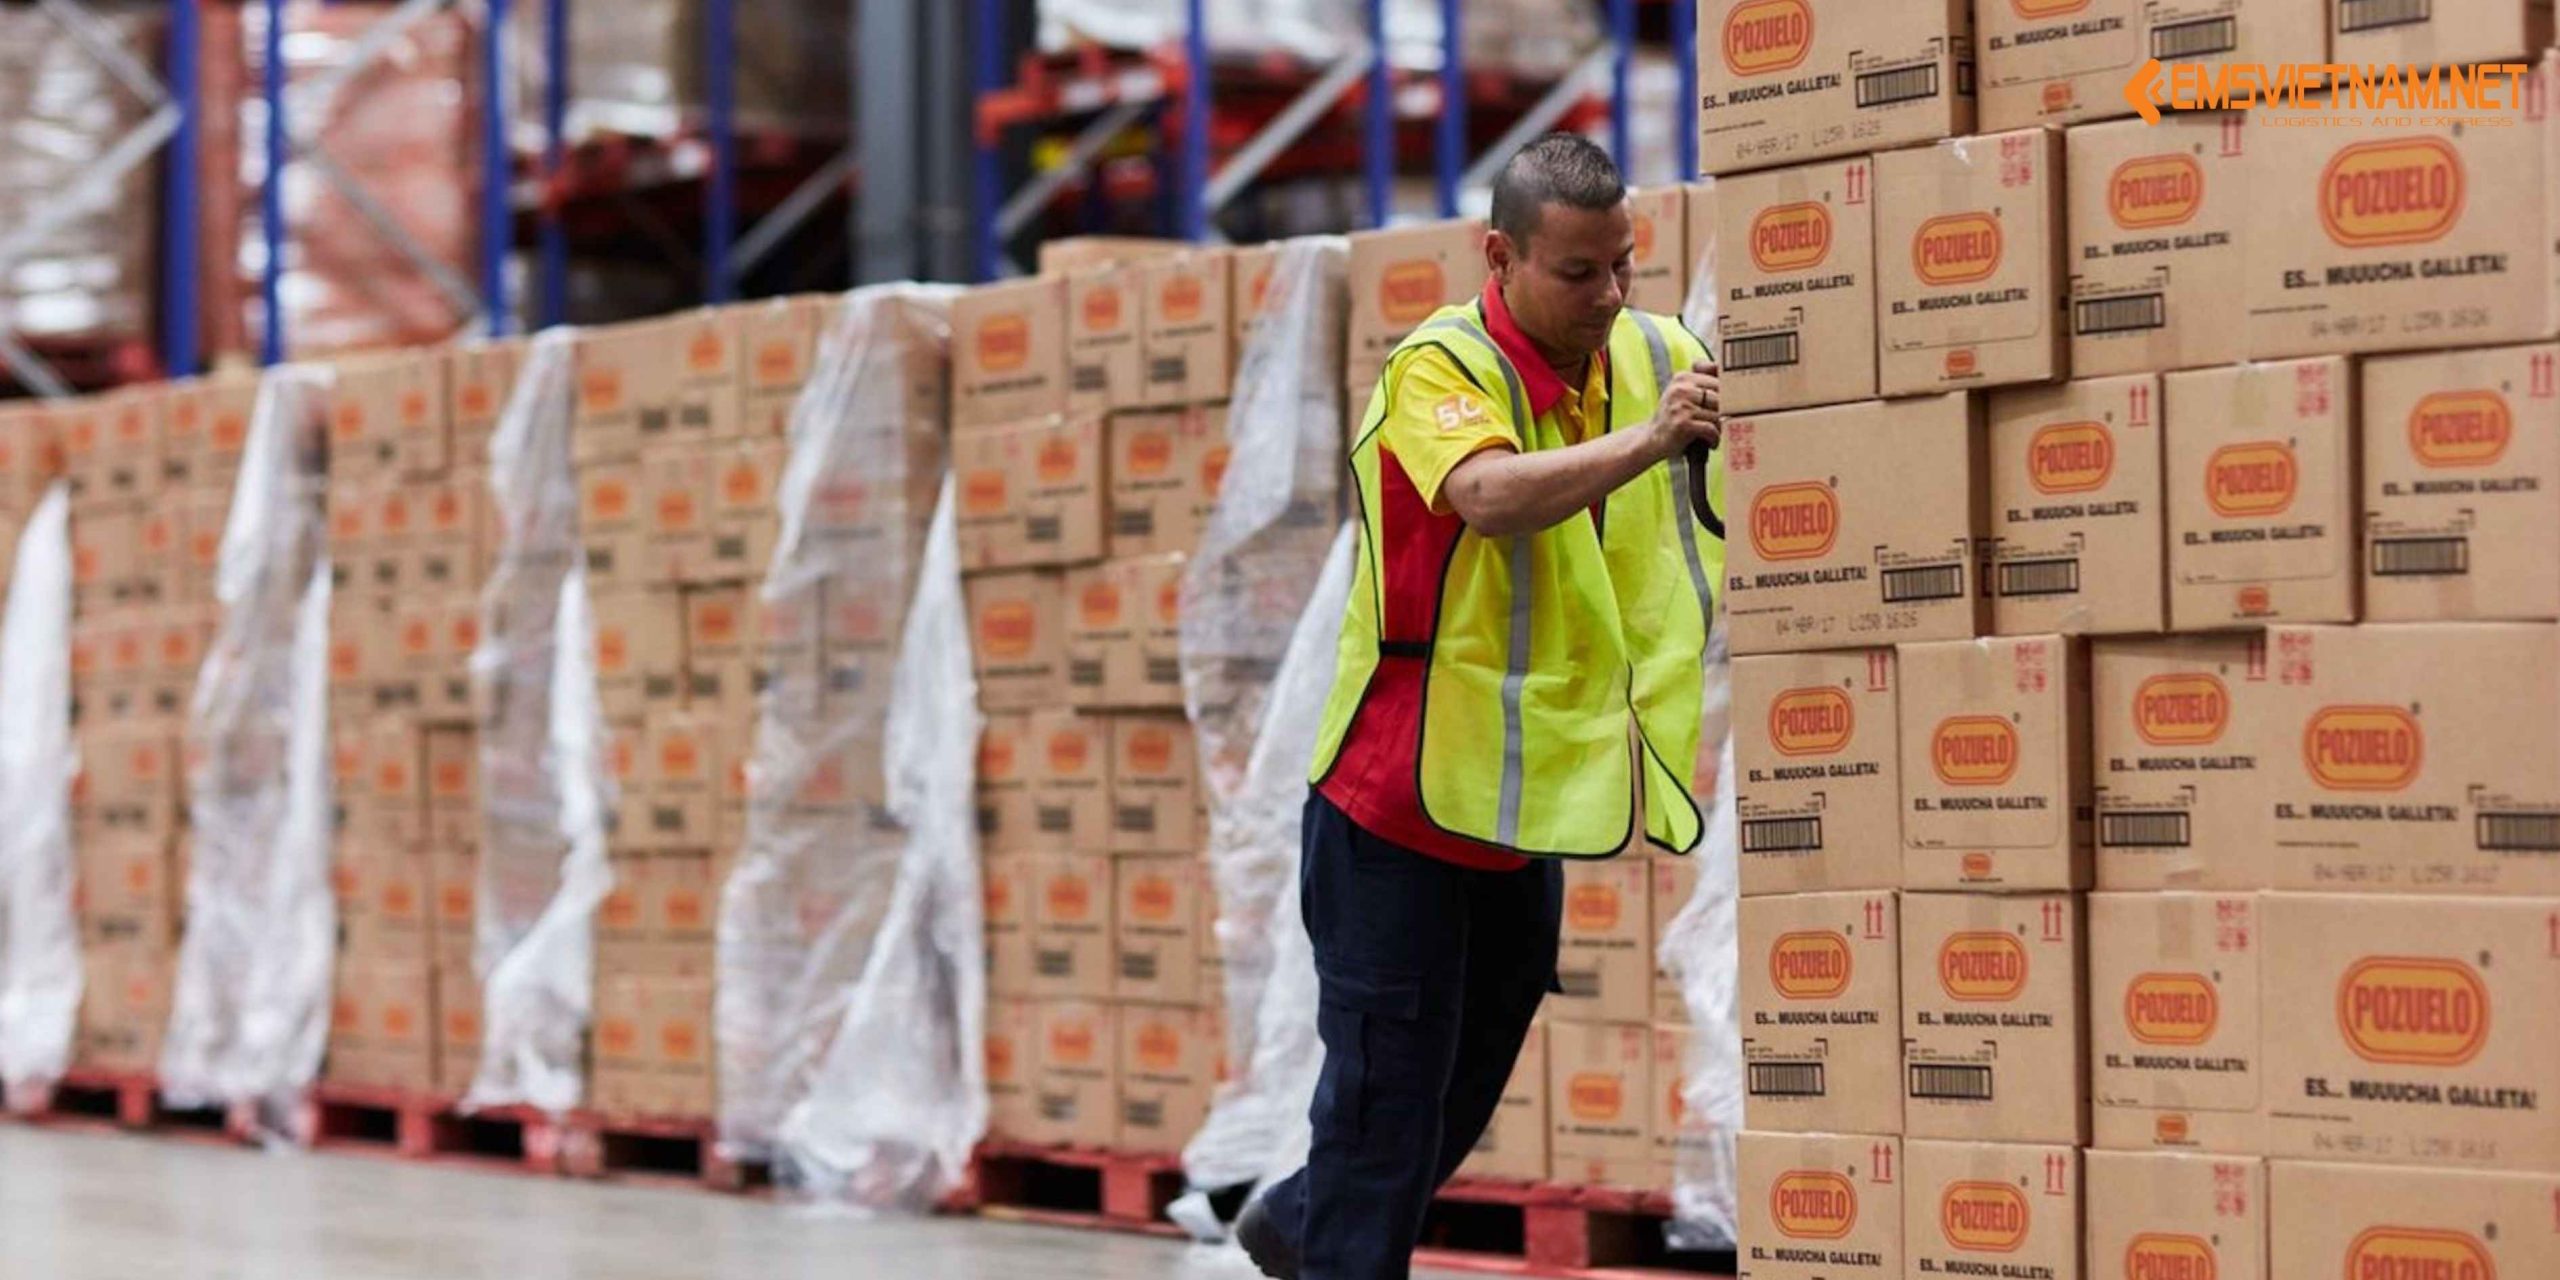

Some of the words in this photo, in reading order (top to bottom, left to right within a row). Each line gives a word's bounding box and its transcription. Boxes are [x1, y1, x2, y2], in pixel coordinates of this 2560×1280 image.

[1732, 15, 1800, 54] POZUELO
[1989, 36, 2012, 50] ES...
[2072, 18, 2122, 36] GALLETA!
[1703, 95, 1725, 109] ES...
[1787, 74, 1841, 95] GALLETA!
[2119, 174, 2191, 209] POZUELO
[2335, 165, 2447, 218] POZUELO
[1759, 225, 1822, 256] POZUELO
[1922, 230, 1991, 267] POZUELO
[2084, 245, 2108, 259] ES...
[2173, 232, 2229, 250] GALLETA!
[2284, 269, 2319, 289] ES...
[2419, 254, 2506, 278] GALLETA!
[1731, 285, 1752, 300] ES...
[1807, 274, 1854, 290] GALLETA!
[1892, 302, 1914, 315] ES...
[1976, 289, 2029, 305] GALLETA!
[1759, 502, 1828, 540] POZUELO
[1730, 577, 1751, 591] ES...
[1814, 567, 1867, 583] GALLETA!
[1779, 704, 1843, 737] POZUELO
[2145, 694, 2217, 726] POZUELO
[1942, 736, 2007, 766] POZUELO
[2318, 729, 2408, 765] POZUELO
[1749, 770, 1770, 782] ES...
[1829, 762, 1879, 777] GALLETA!
[2110, 758, 2134, 772] ES...
[2200, 756, 2255, 770] GALLETA!
[1915, 798, 1937, 811] ES...
[1997, 796, 2047, 810] GALLETA!
[2276, 804, 2305, 819] ES...
[2388, 805, 2458, 821] GALLETA!
[1779, 950, 1841, 980] POZUELO
[1950, 951, 2016, 982] POZUELO
[1756, 1012, 1776, 1024] ES...
[1831, 1011, 1879, 1025] GALLETA!
[1918, 1012, 1940, 1025] ES...
[2001, 1014, 2052, 1028] GALLETA!
[2135, 993, 2206, 1024] POZUELO
[2355, 985, 2470, 1035] POZUELO
[2105, 1055, 2129, 1069] ES...
[2195, 1057, 2247, 1072] GALLETA!
[2305, 1078, 2342, 1099] ES...
[2449, 1086, 2537, 1110] GALLETA!
[1780, 1190, 1845, 1220] POZUELO
[1950, 1201, 2018, 1233] POZUELO
[1752, 1247, 1773, 1259] ES...
[1830, 1252, 1882, 1266] GALLETA!
[1920, 1259, 1942, 1272] ES...
[2002, 1265, 2054, 1279] GALLETA!
[2136, 1252, 2205, 1280] POZUELO
